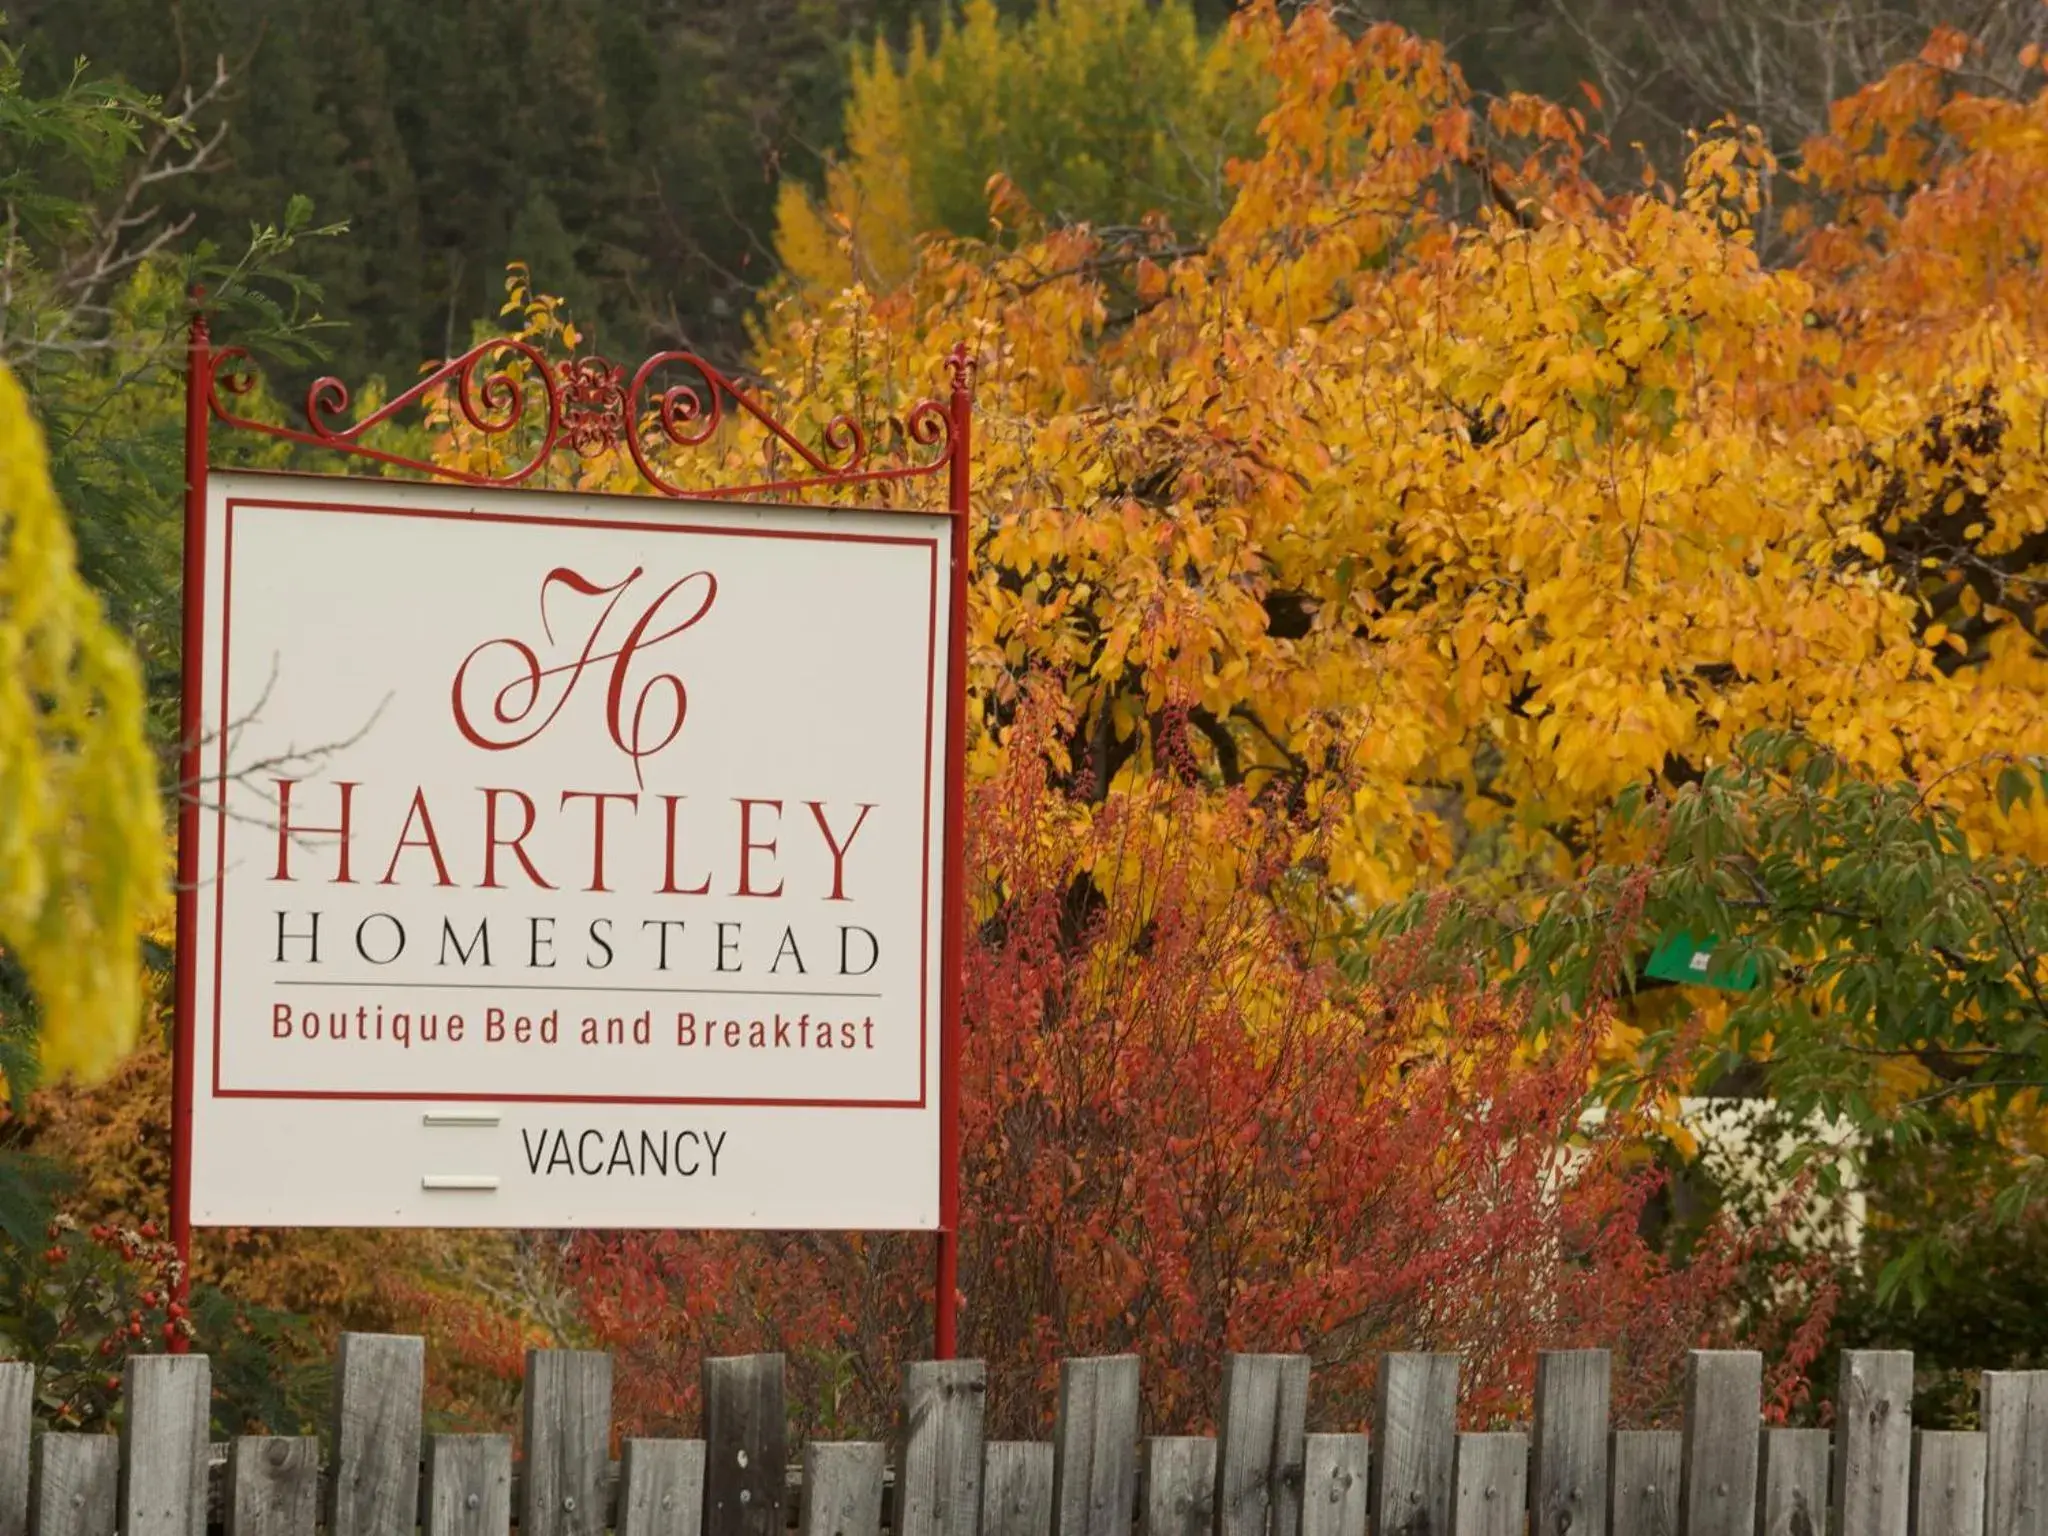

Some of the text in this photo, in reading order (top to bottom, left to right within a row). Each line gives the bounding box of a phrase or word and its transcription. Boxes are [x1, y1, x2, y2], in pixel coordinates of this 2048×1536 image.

[266, 778, 880, 902] HARTLEY
[273, 910, 881, 976] HOMESTEAD
[272, 1003, 875, 1049] Boutique Bed and Breakfast
[522, 1128, 727, 1177] VACANCY
